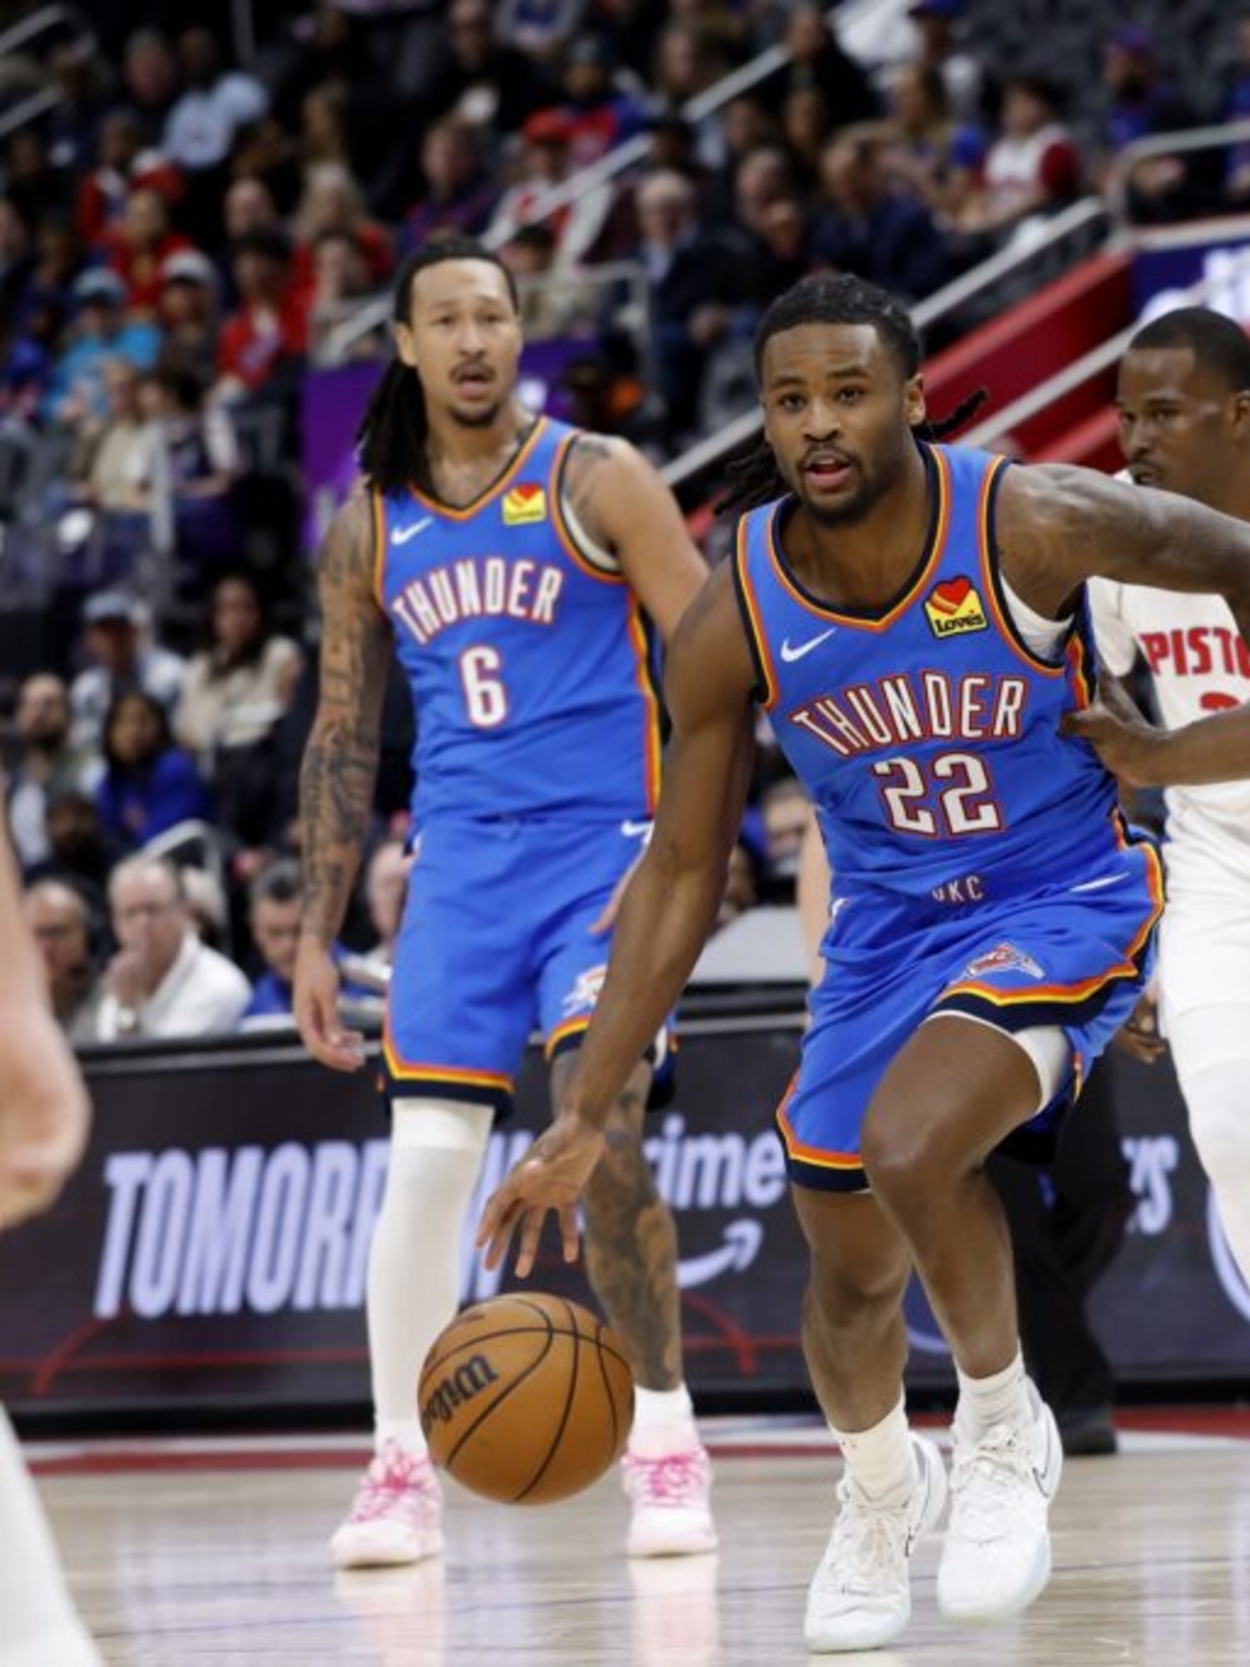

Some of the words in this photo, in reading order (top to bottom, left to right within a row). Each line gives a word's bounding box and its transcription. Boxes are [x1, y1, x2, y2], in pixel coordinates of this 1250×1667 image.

[391, 557, 564, 646] THUNDER
[460, 643, 508, 729] 6
[788, 669, 1029, 757] THUNDER
[870, 751, 1006, 838] 22
